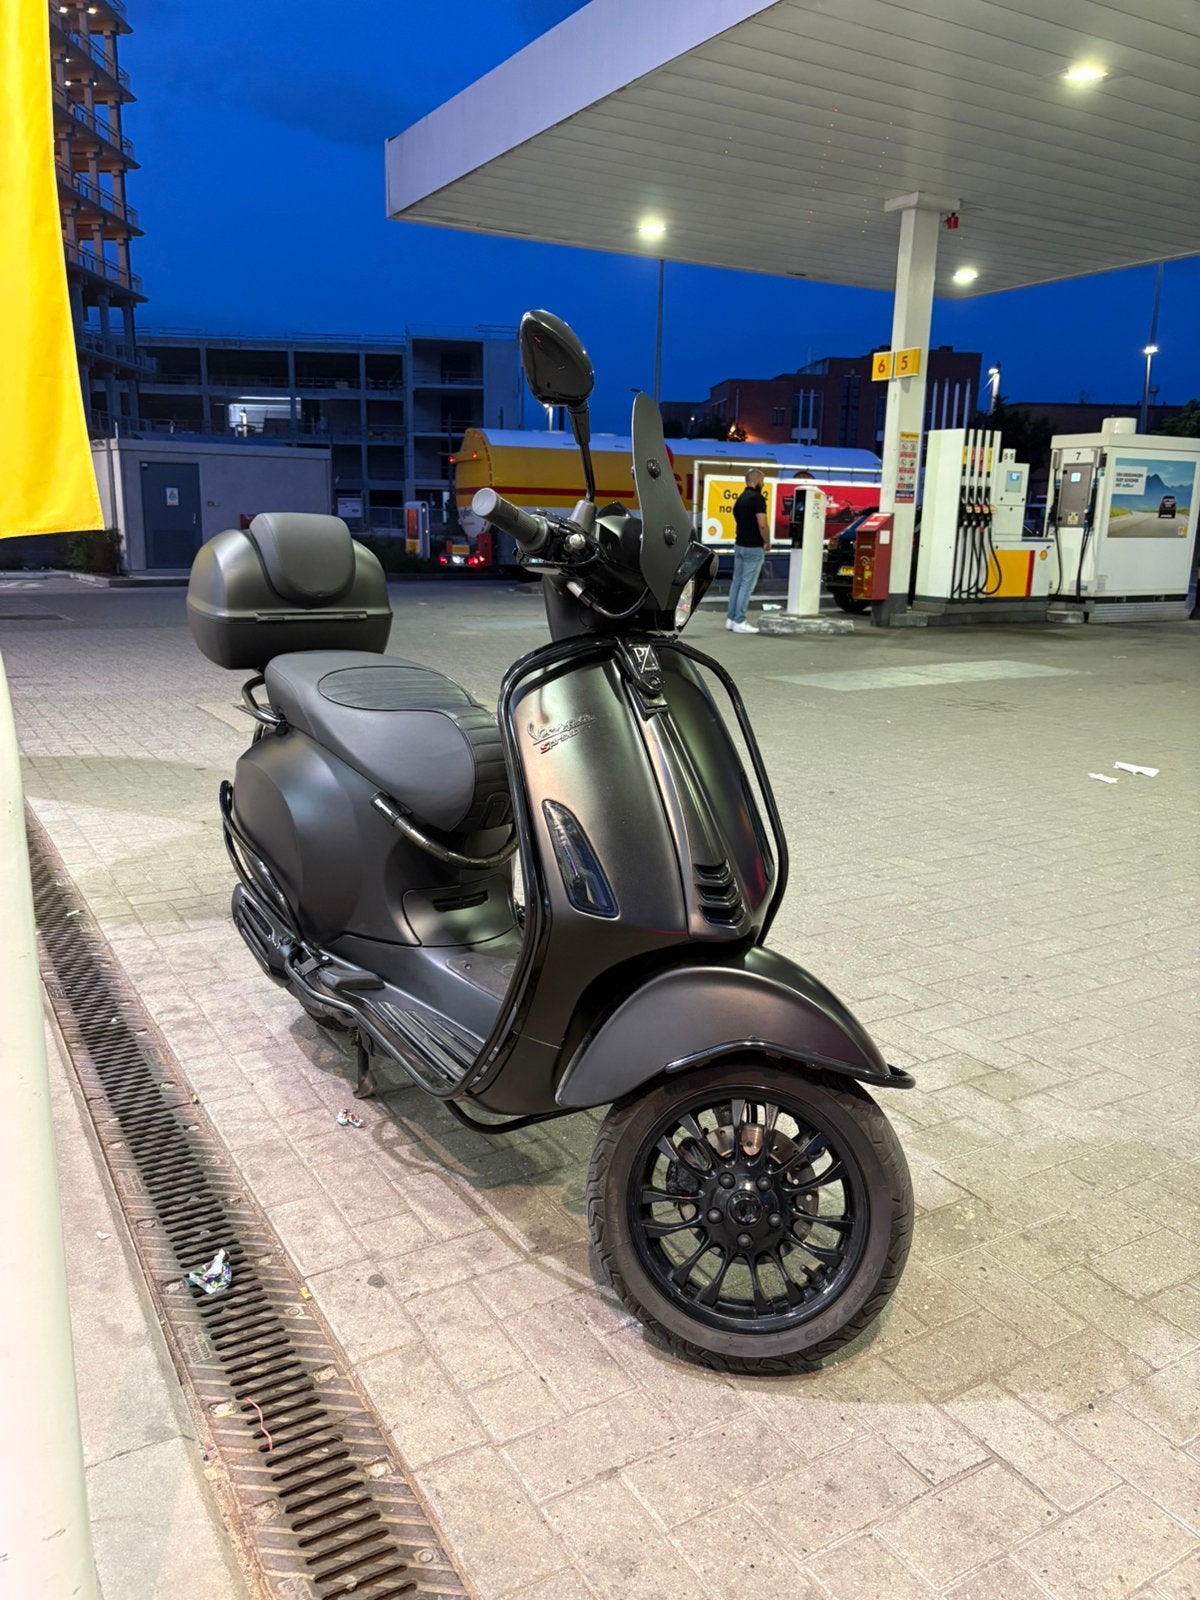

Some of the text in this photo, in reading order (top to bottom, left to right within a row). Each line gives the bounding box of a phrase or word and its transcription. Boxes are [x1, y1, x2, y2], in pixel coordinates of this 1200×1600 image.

[878, 355, 909, 374] 6 5
[1076, 451, 1082, 461] 7
